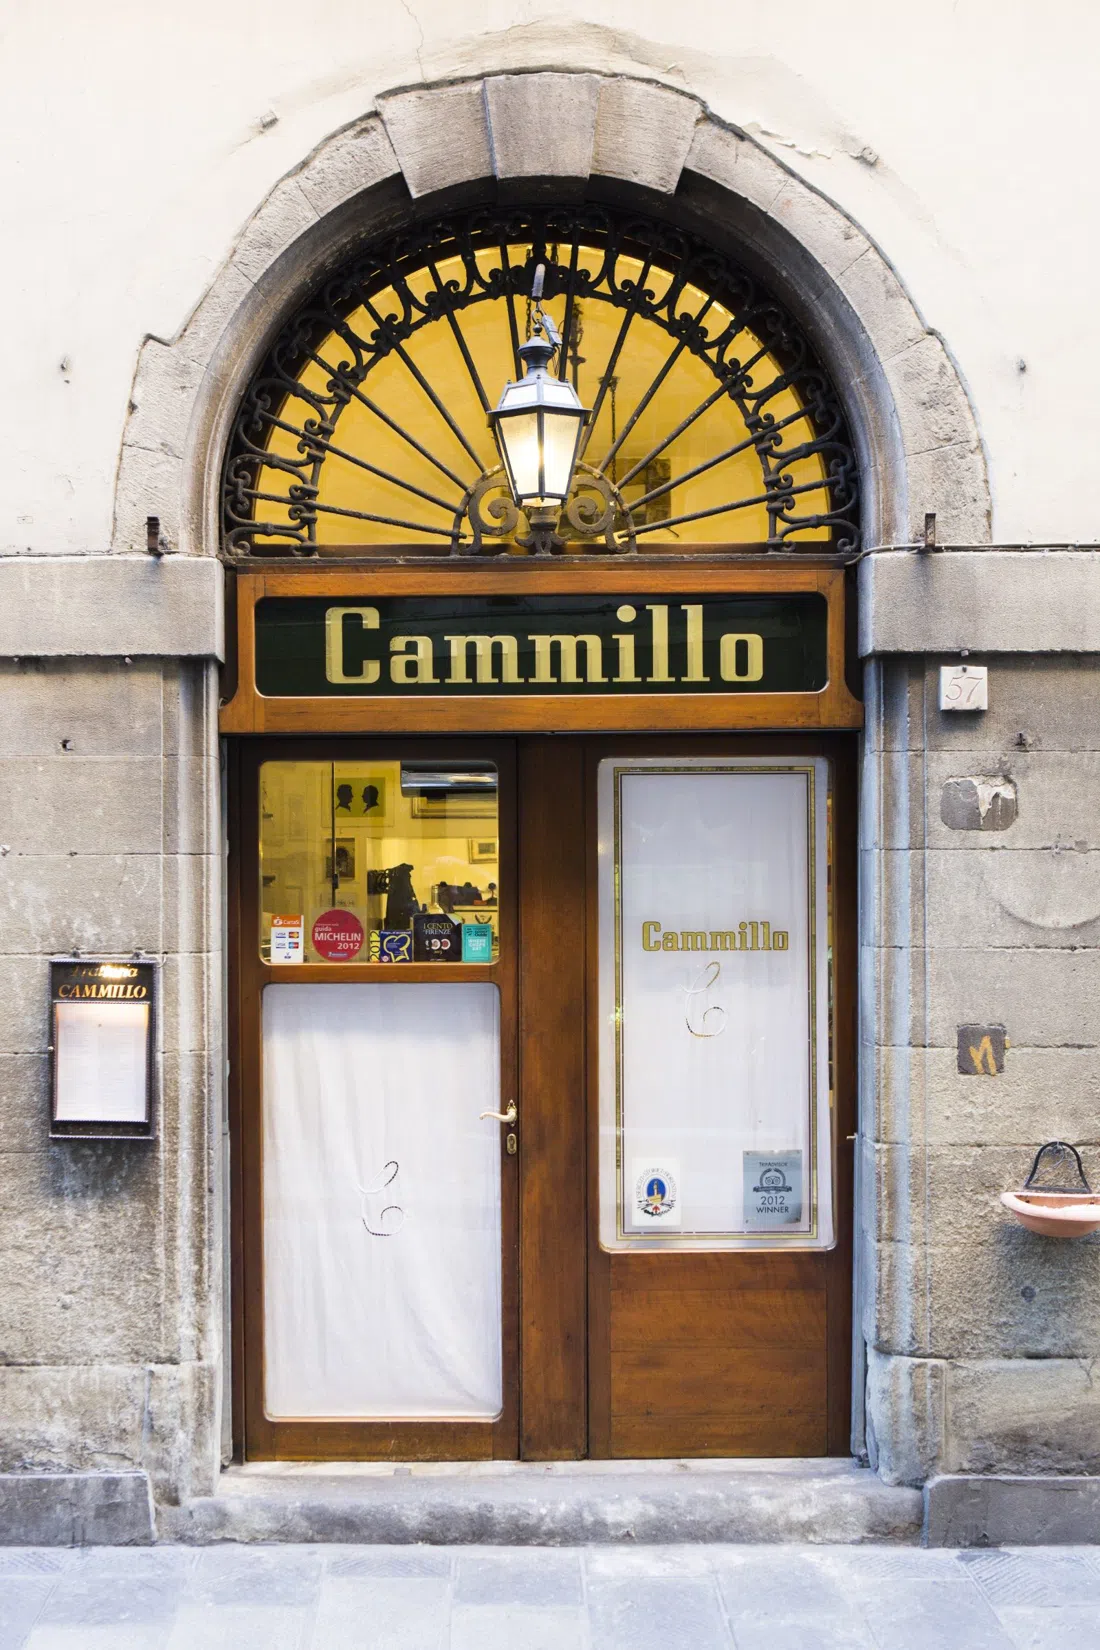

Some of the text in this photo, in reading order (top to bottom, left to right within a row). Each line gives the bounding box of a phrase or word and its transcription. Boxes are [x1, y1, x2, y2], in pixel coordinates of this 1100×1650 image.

[325, 604, 764, 685] Cammillo
[945, 675, 984, 703] 57
[427, 922, 453, 930] CENTO
[314, 932, 361, 941] MICHELIN
[642, 921, 788, 951] Cammillo
[337, 942, 360, 950] 2012
[370, 931, 380, 961] 2012
[58, 984, 147, 998] CAMMILLO
[760, 1195, 785, 1206] 2012
